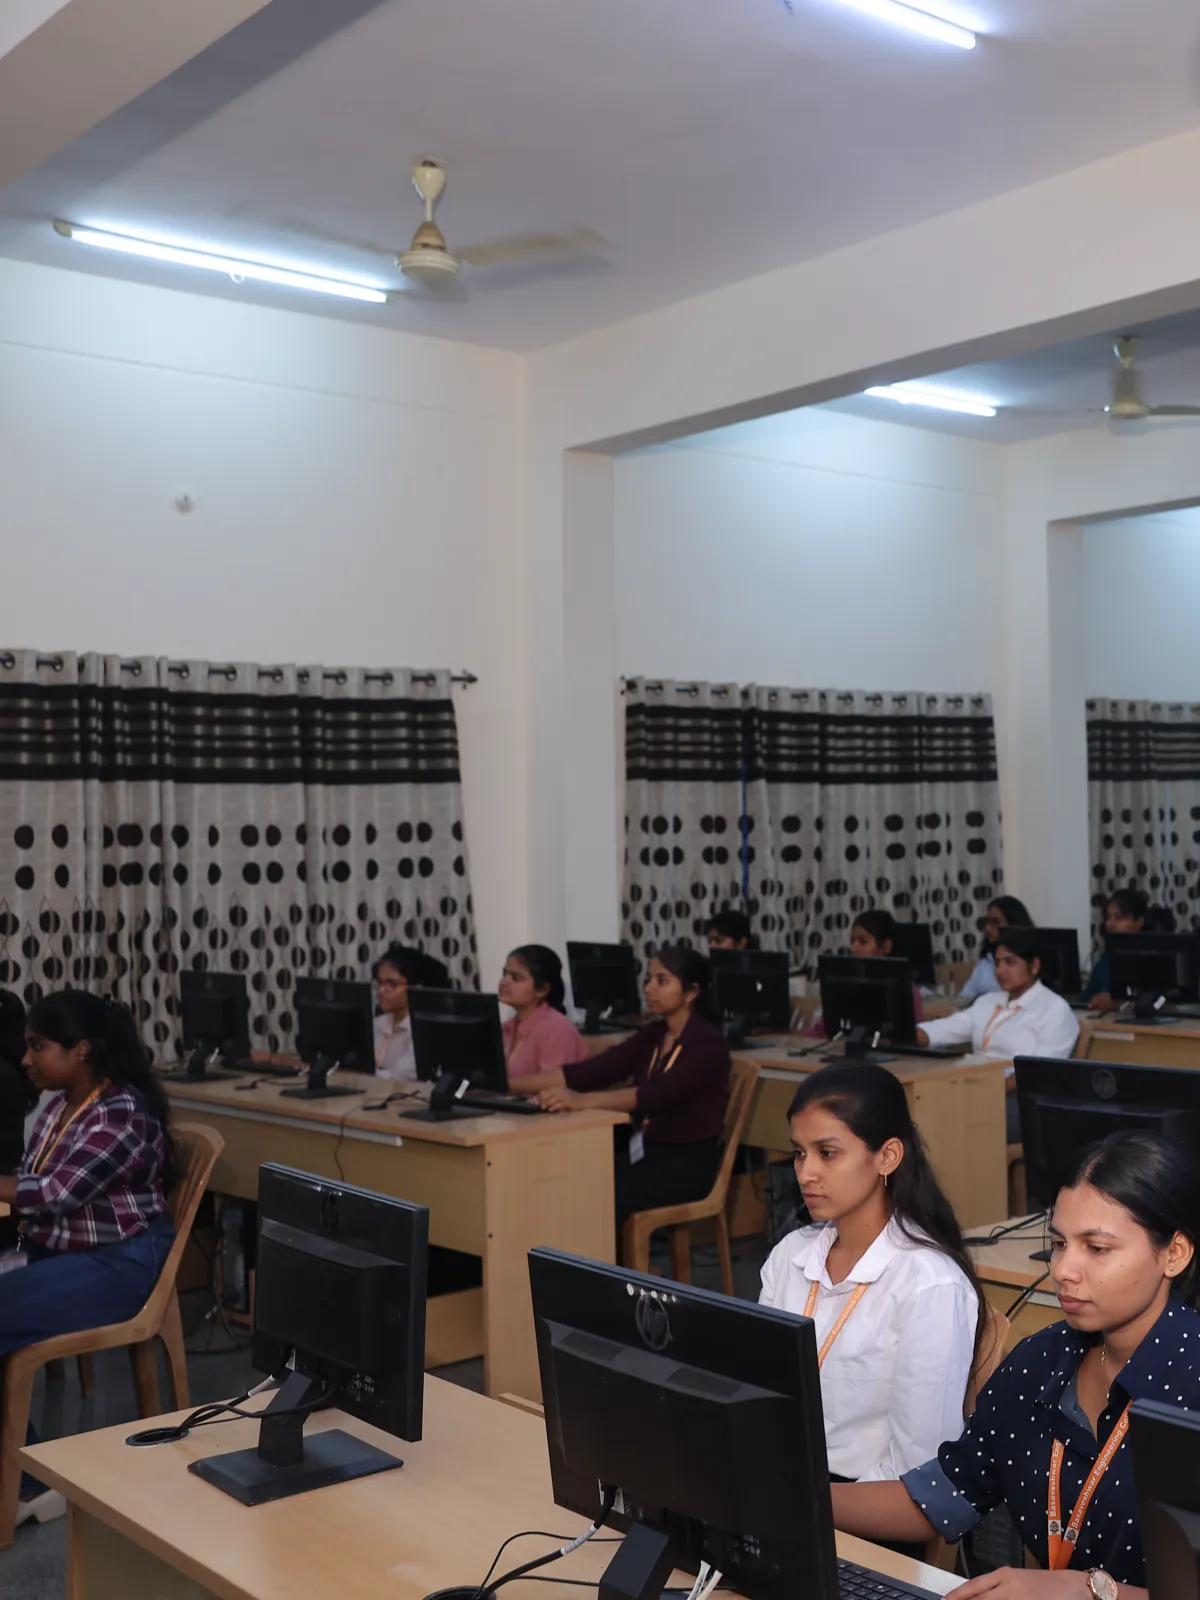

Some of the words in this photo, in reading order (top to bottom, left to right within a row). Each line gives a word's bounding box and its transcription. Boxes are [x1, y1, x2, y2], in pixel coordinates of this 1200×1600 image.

[1050, 1459, 1058, 1517] Basaveshwar
[1071, 1475, 1097, 1529] Basaveshwar
[1093, 1427, 1124, 1476] Engineering
